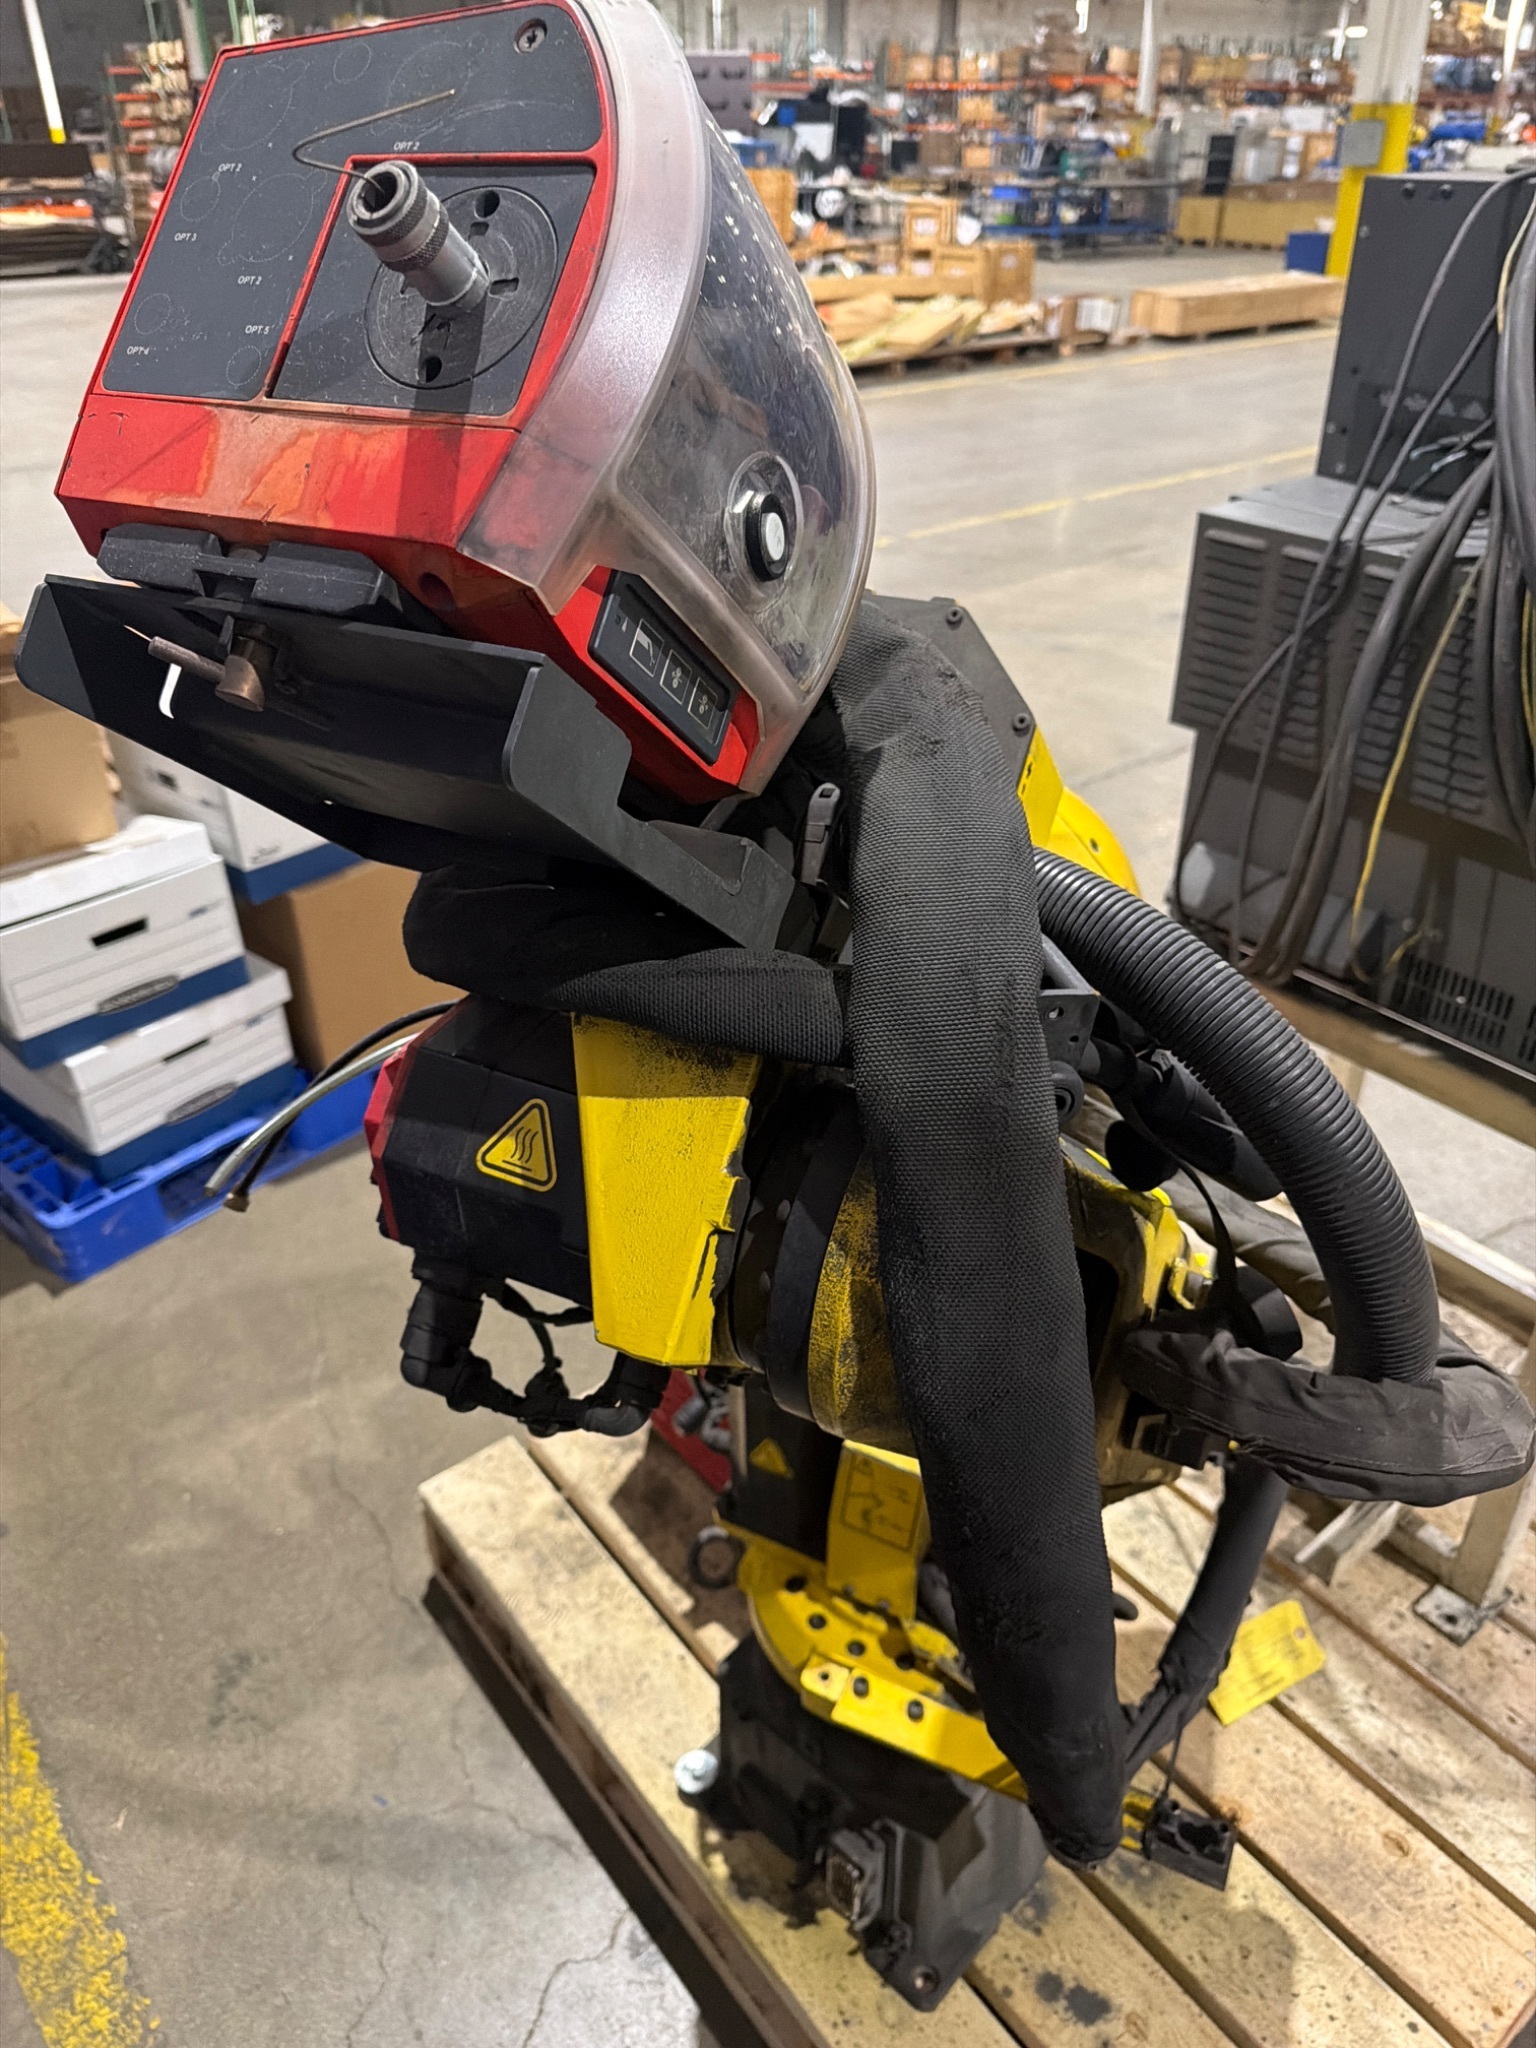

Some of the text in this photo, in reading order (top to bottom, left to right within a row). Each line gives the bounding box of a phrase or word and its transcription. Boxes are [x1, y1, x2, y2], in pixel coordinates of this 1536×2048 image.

[393, 141, 413, 151] OPT
[218, 163, 236, 172] OPT
[174, 232, 191, 241] OPT
[237, 275, 256, 285] OPT
[245, 325, 263, 334] OPT
[126, 346, 144, 355] OPT
